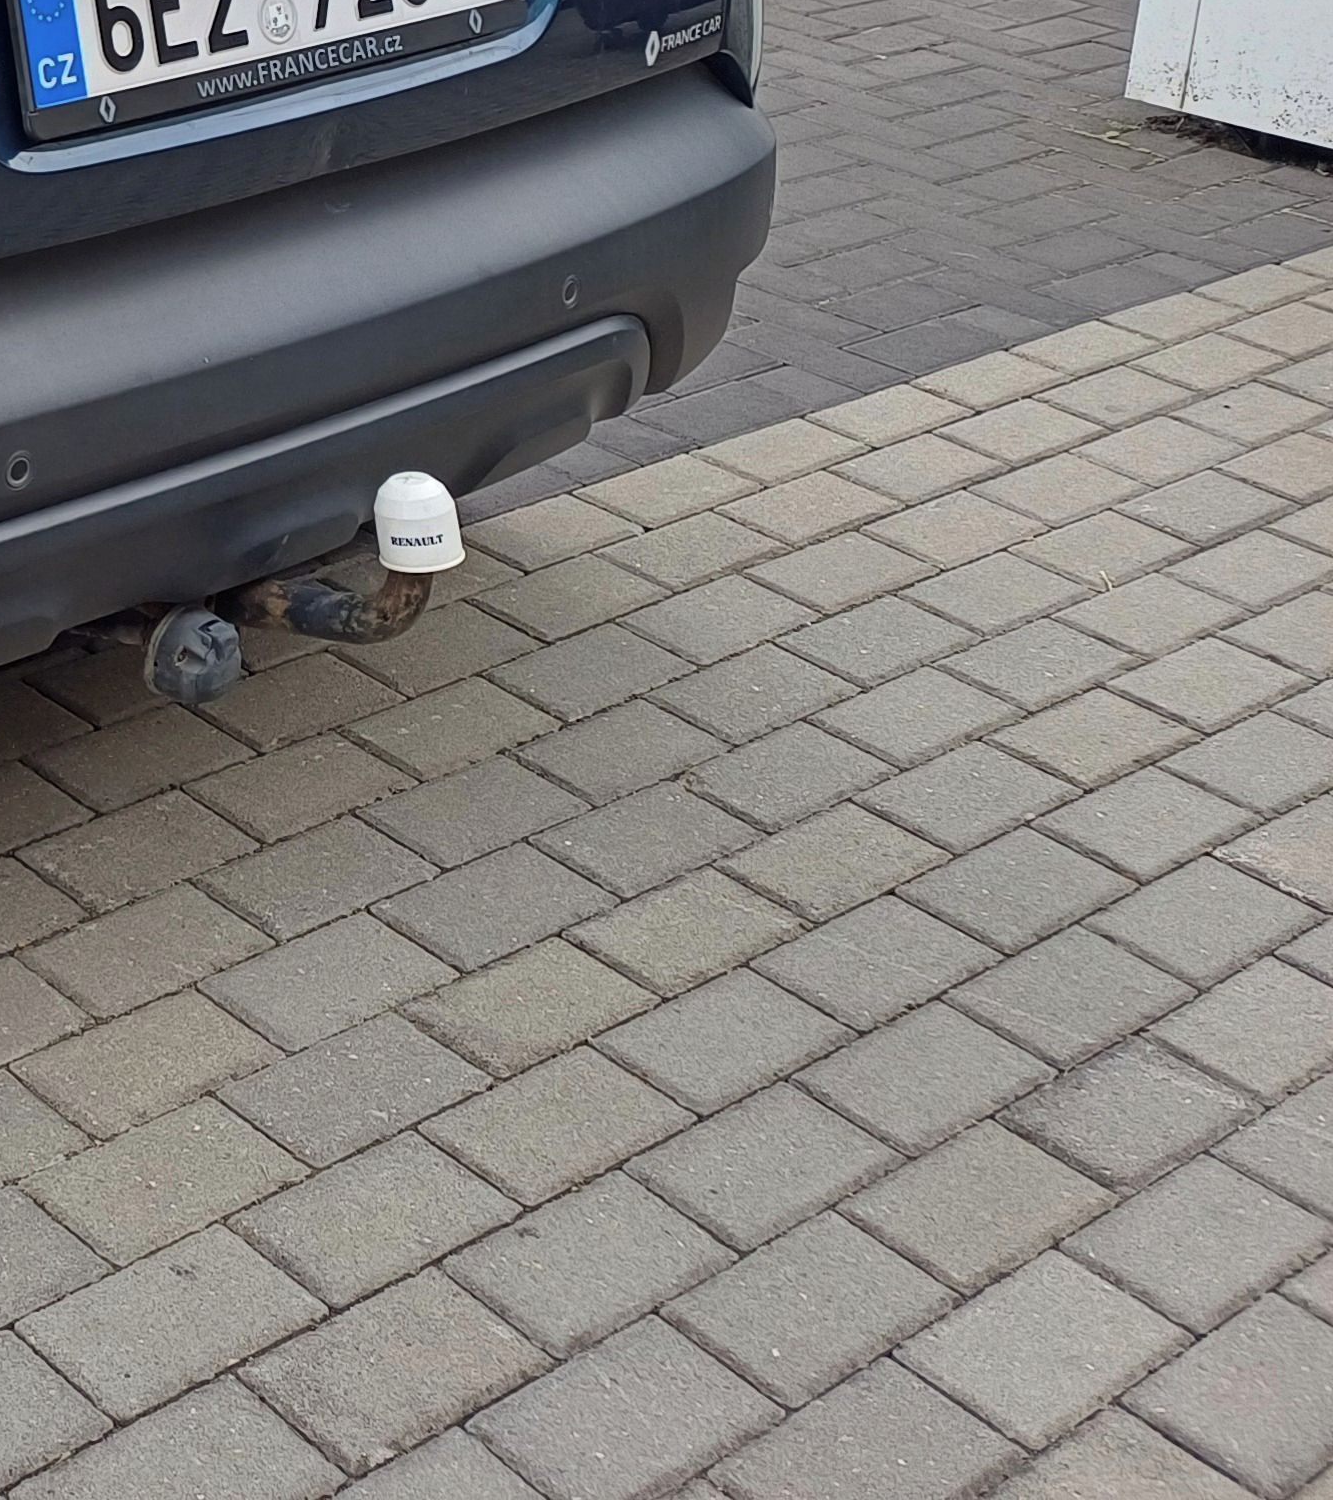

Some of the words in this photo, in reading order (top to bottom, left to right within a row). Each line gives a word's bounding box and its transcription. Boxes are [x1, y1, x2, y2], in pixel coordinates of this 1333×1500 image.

[660, 22, 702, 53] FRANCE
[702, 14, 723, 36] CAR
[37, 52, 78, 89] CZ
[390, 533, 444, 547] RENAULT
